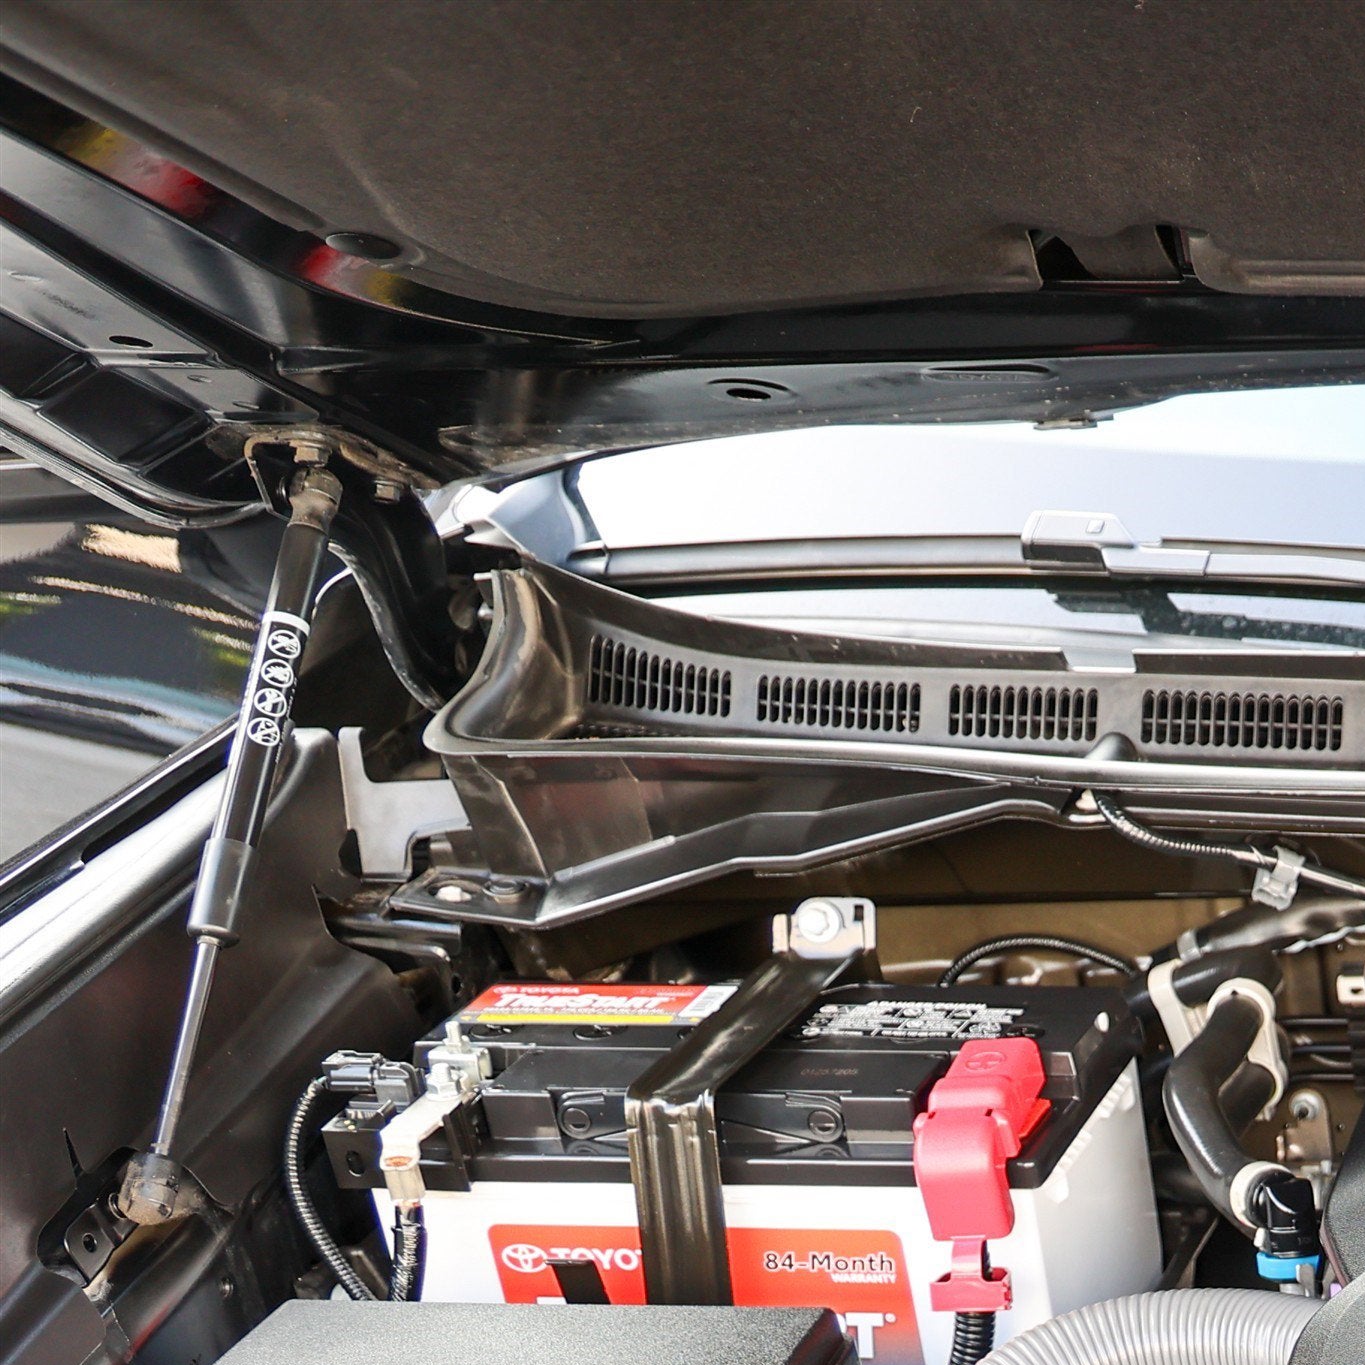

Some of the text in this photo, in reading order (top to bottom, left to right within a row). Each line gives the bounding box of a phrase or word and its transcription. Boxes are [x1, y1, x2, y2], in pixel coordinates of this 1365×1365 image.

[548, 1246, 643, 1271] TOYO
[763, 1250, 897, 1273] 84-Month
[830, 1272, 896, 1284] WARRANTY
